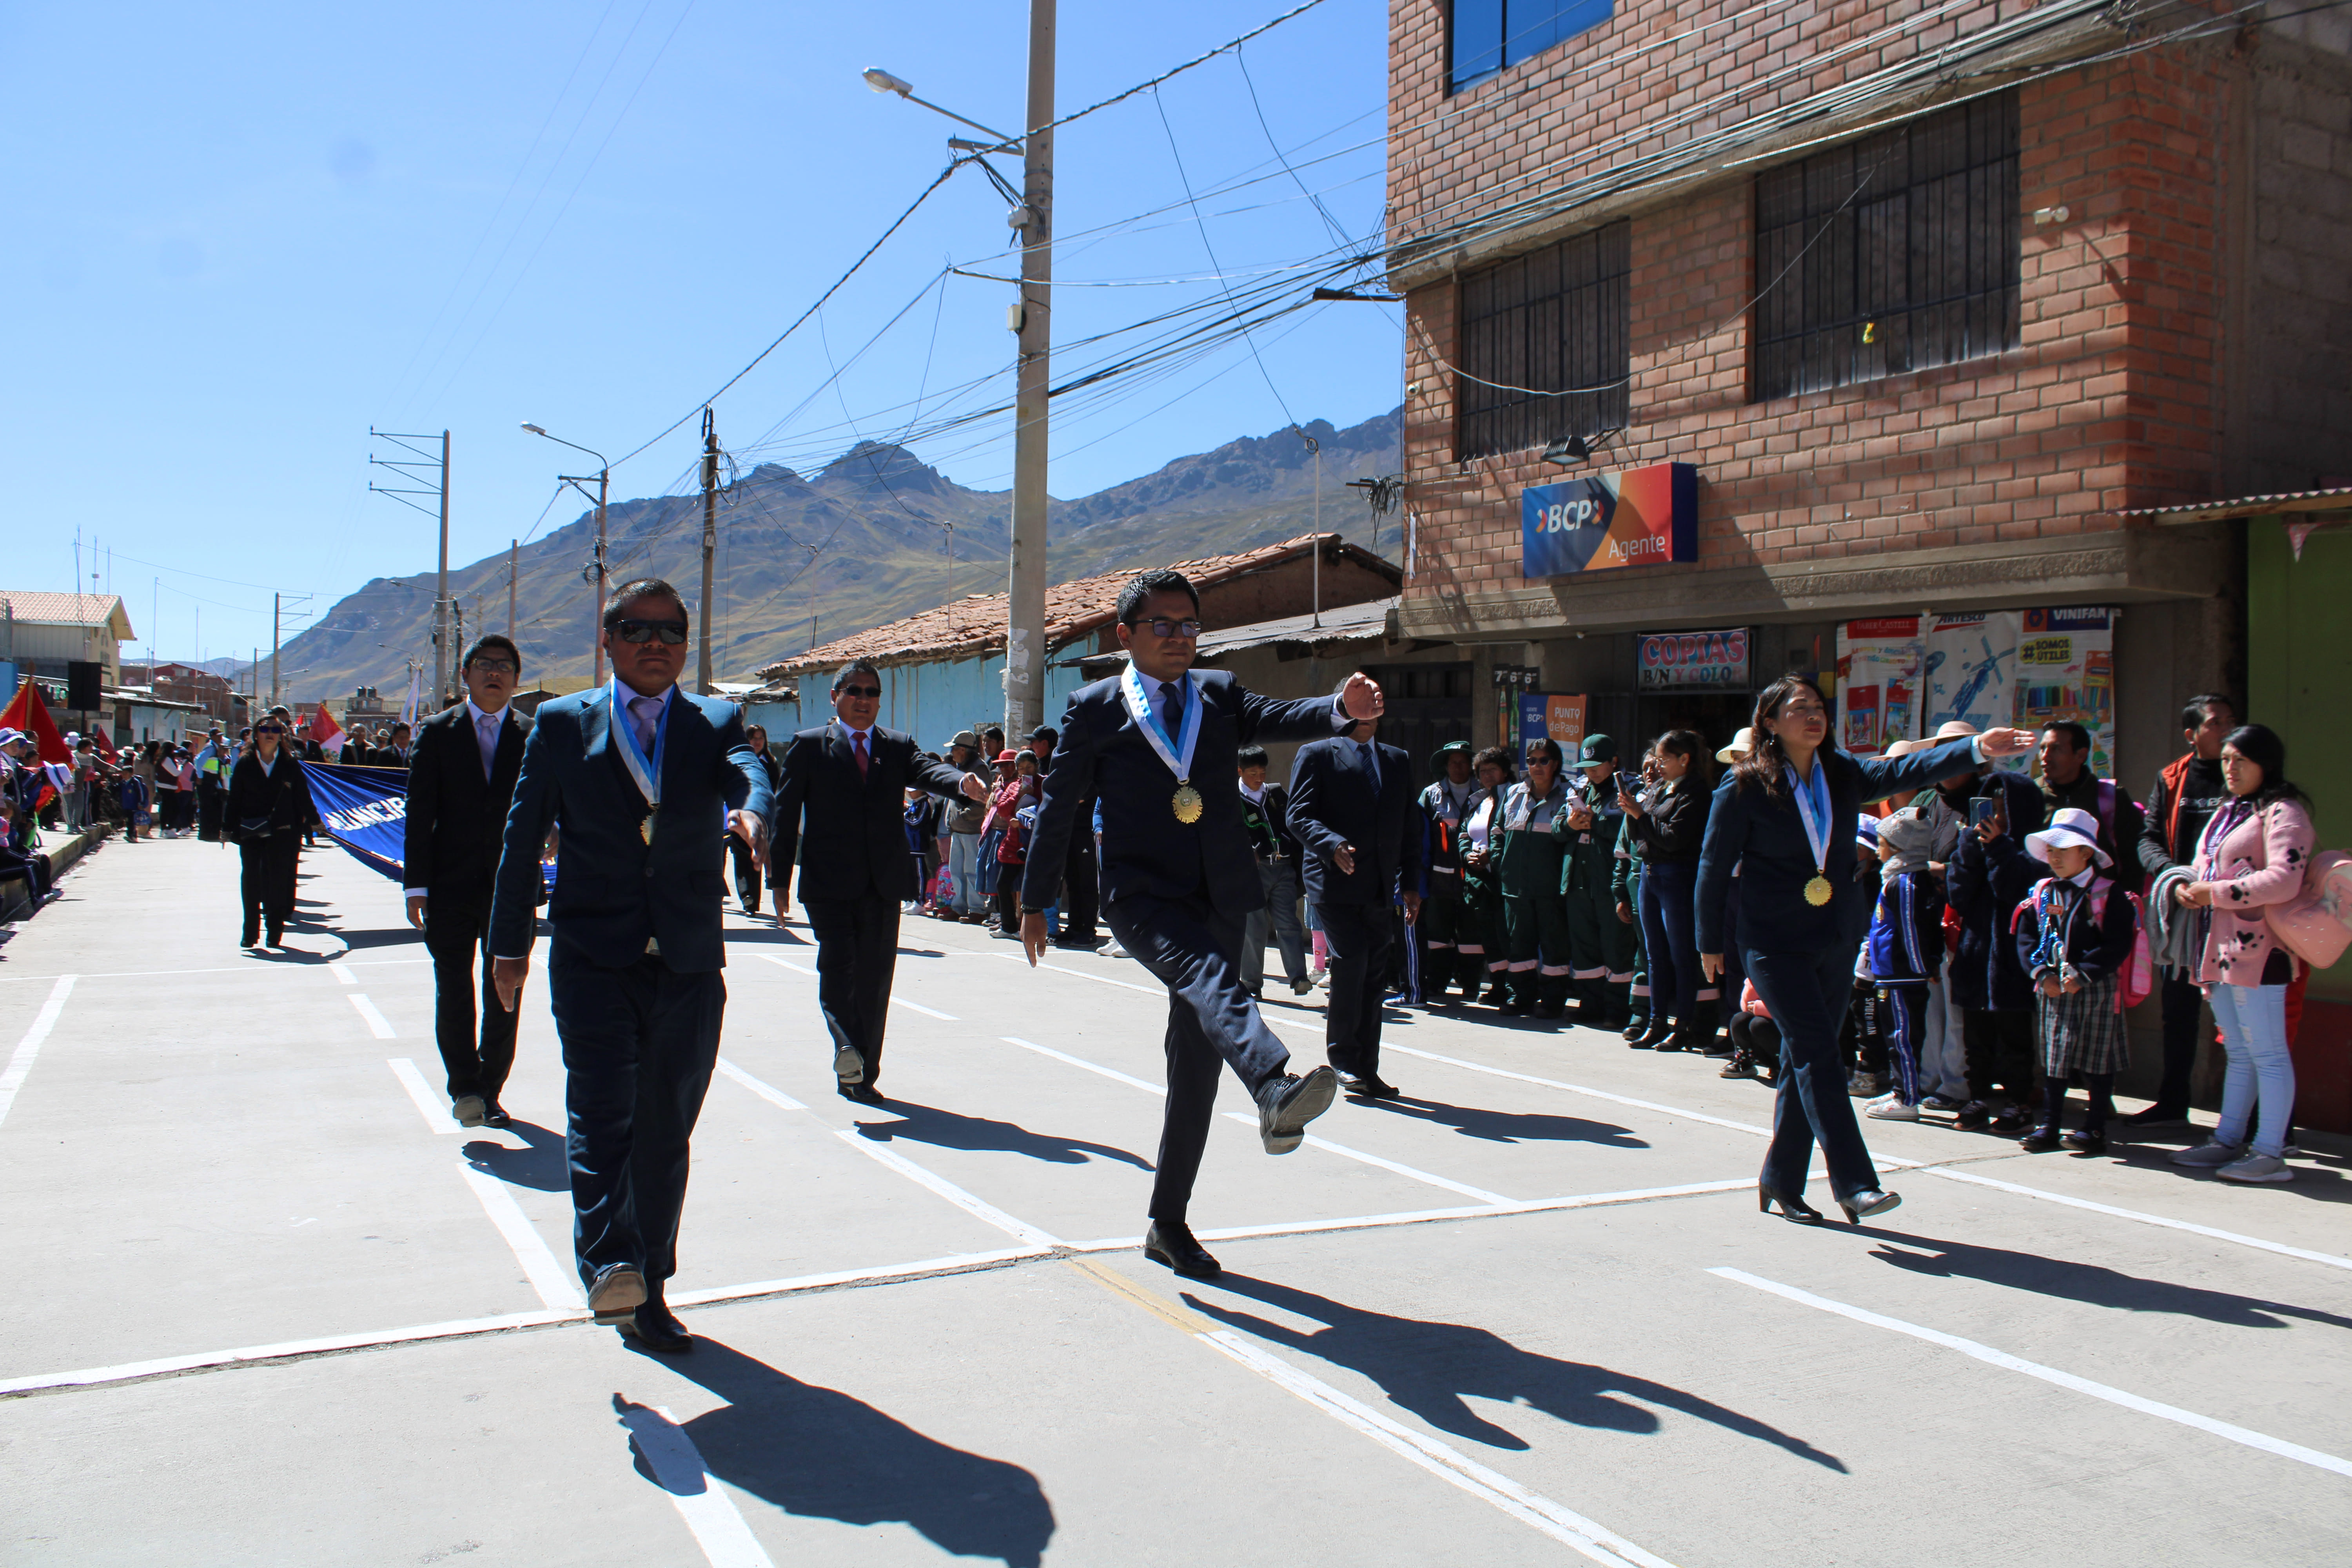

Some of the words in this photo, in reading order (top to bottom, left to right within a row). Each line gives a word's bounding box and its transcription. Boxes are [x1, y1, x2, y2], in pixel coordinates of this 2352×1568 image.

[1547, 499, 1592, 533] BCP
[1608, 534, 1666, 562] Agente
[1938, 614, 1986, 624] ARTESCO
[1642, 632, 1746, 666] COPIAS
[2036, 639, 2070, 650] SOMOS
[1644, 668, 1670, 683] B/N
[1674, 668, 1685, 682] Y
[1688, 666, 1743, 682] COLOR
[1527, 713, 1541, 722] BCP
[1549, 721, 1560, 732] de
[1561, 722, 1579, 736] Pago
[1865, 997, 1875, 1020] SPIDER
